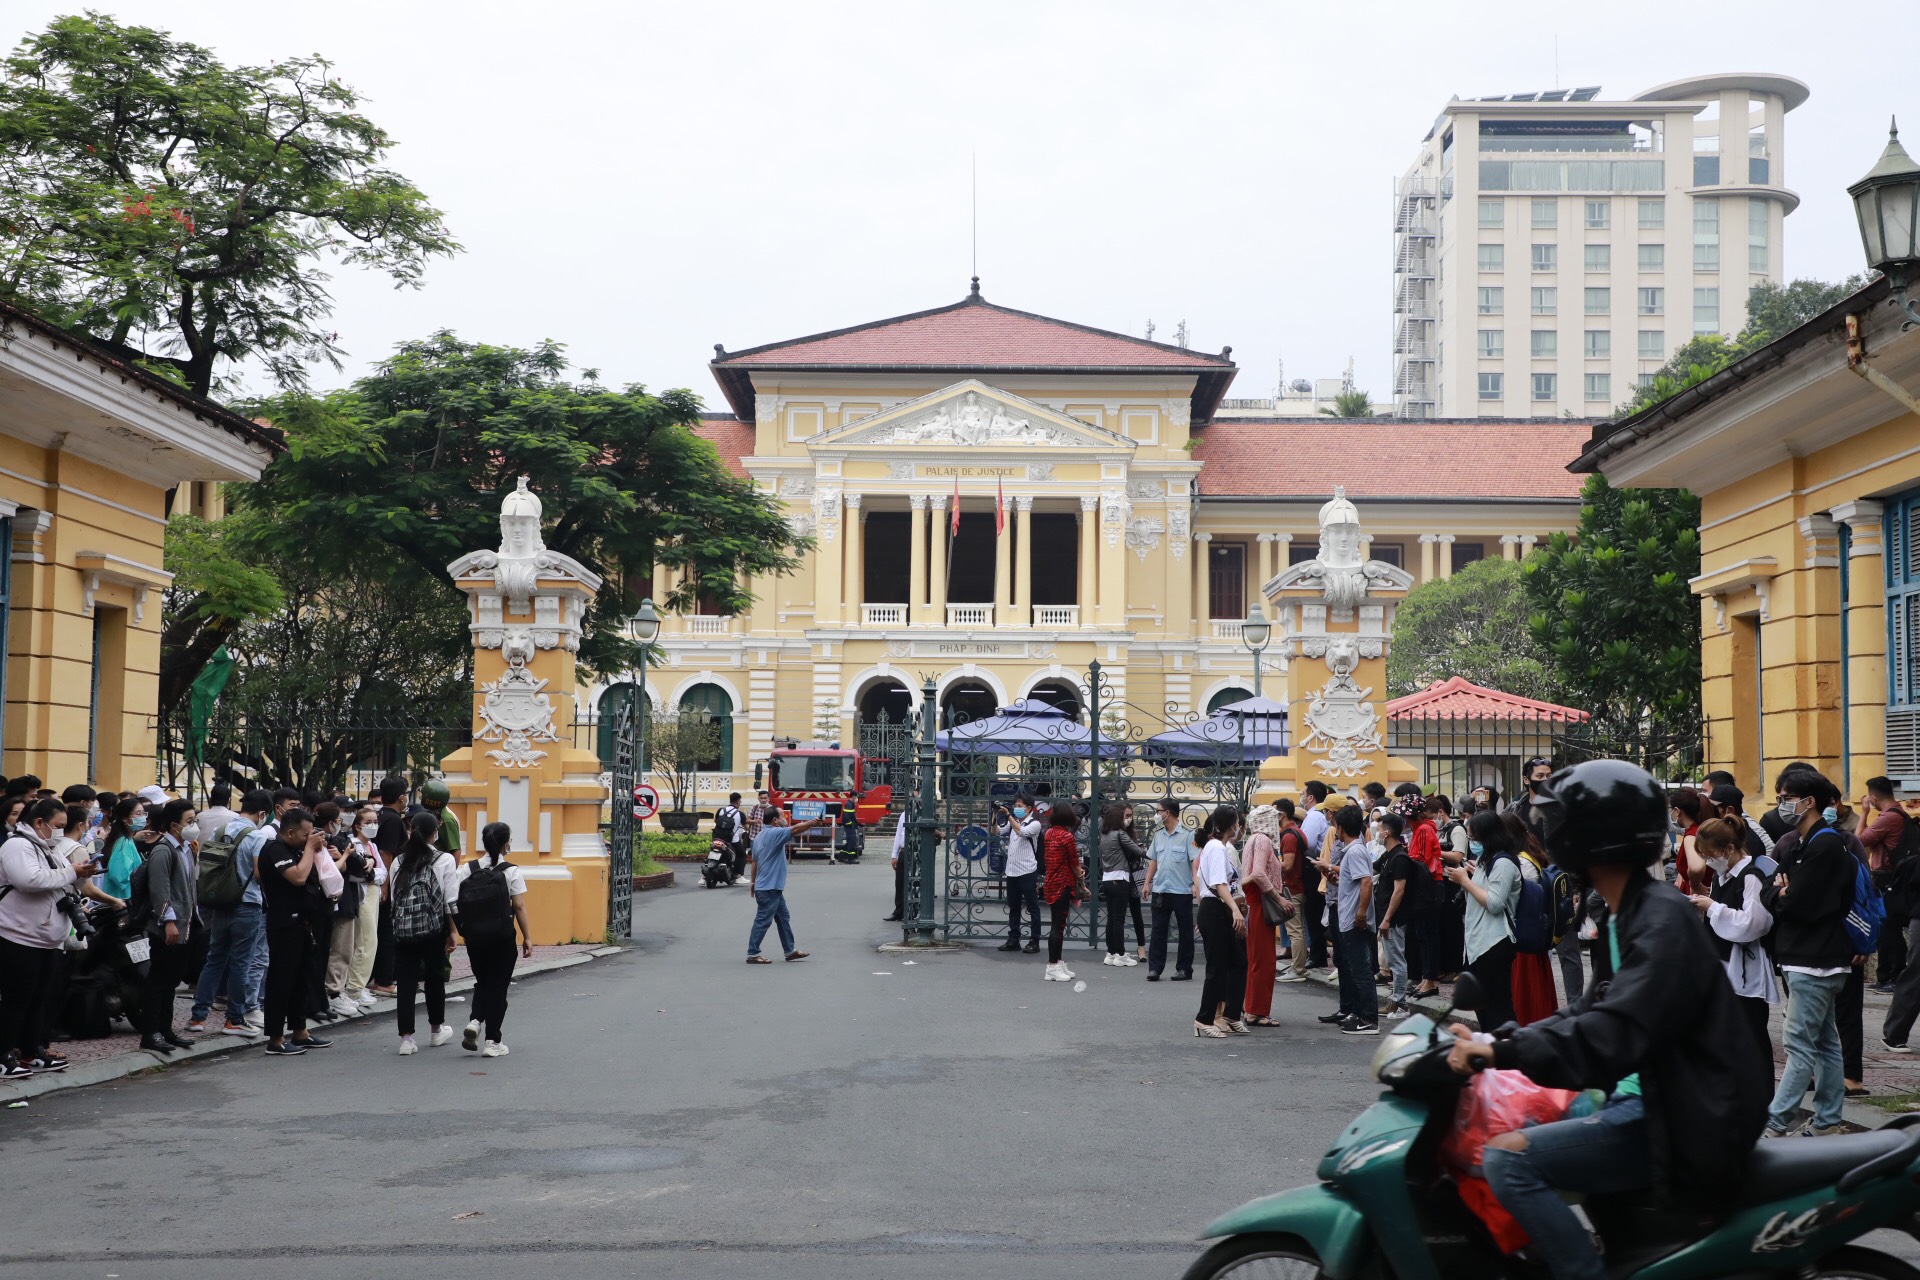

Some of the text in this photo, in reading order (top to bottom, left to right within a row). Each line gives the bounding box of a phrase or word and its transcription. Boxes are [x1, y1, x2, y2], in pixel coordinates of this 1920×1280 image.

[925, 467, 1015, 476] PALAIS DE JUSTICE
